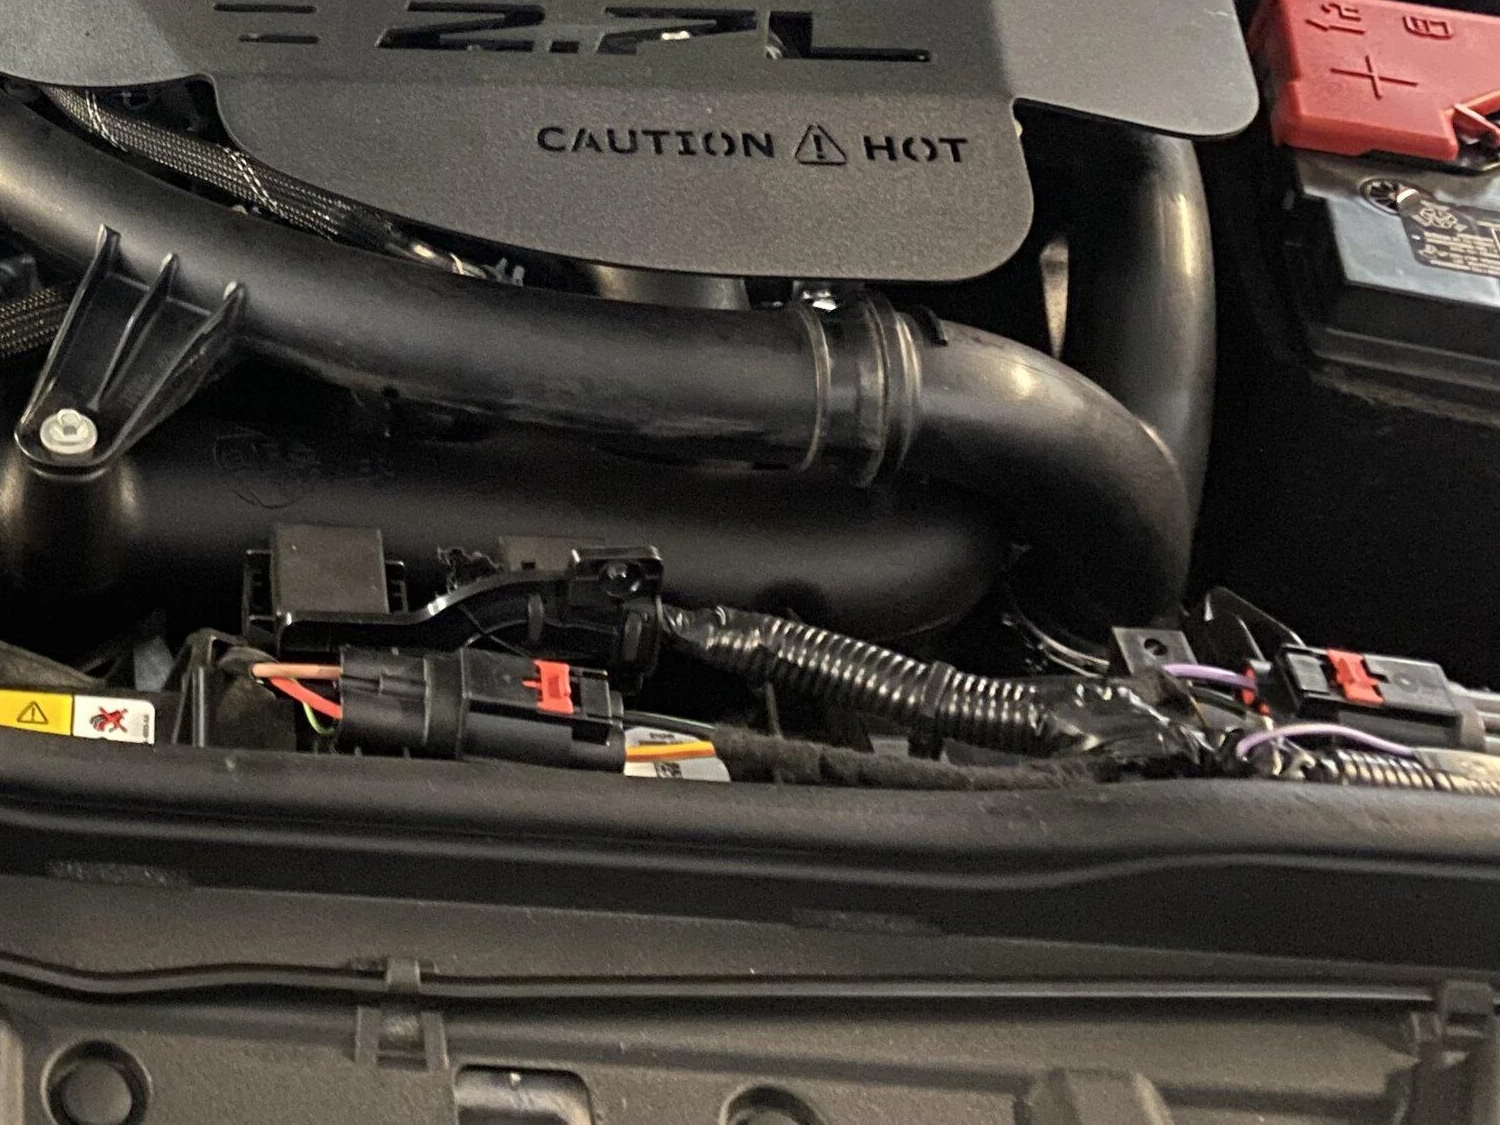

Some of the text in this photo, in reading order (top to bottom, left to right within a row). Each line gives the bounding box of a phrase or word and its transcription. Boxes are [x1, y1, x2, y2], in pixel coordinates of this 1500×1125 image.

[375, 0, 931, 62] 2.7L
[537, 126, 968, 163] CAUTION HOT
